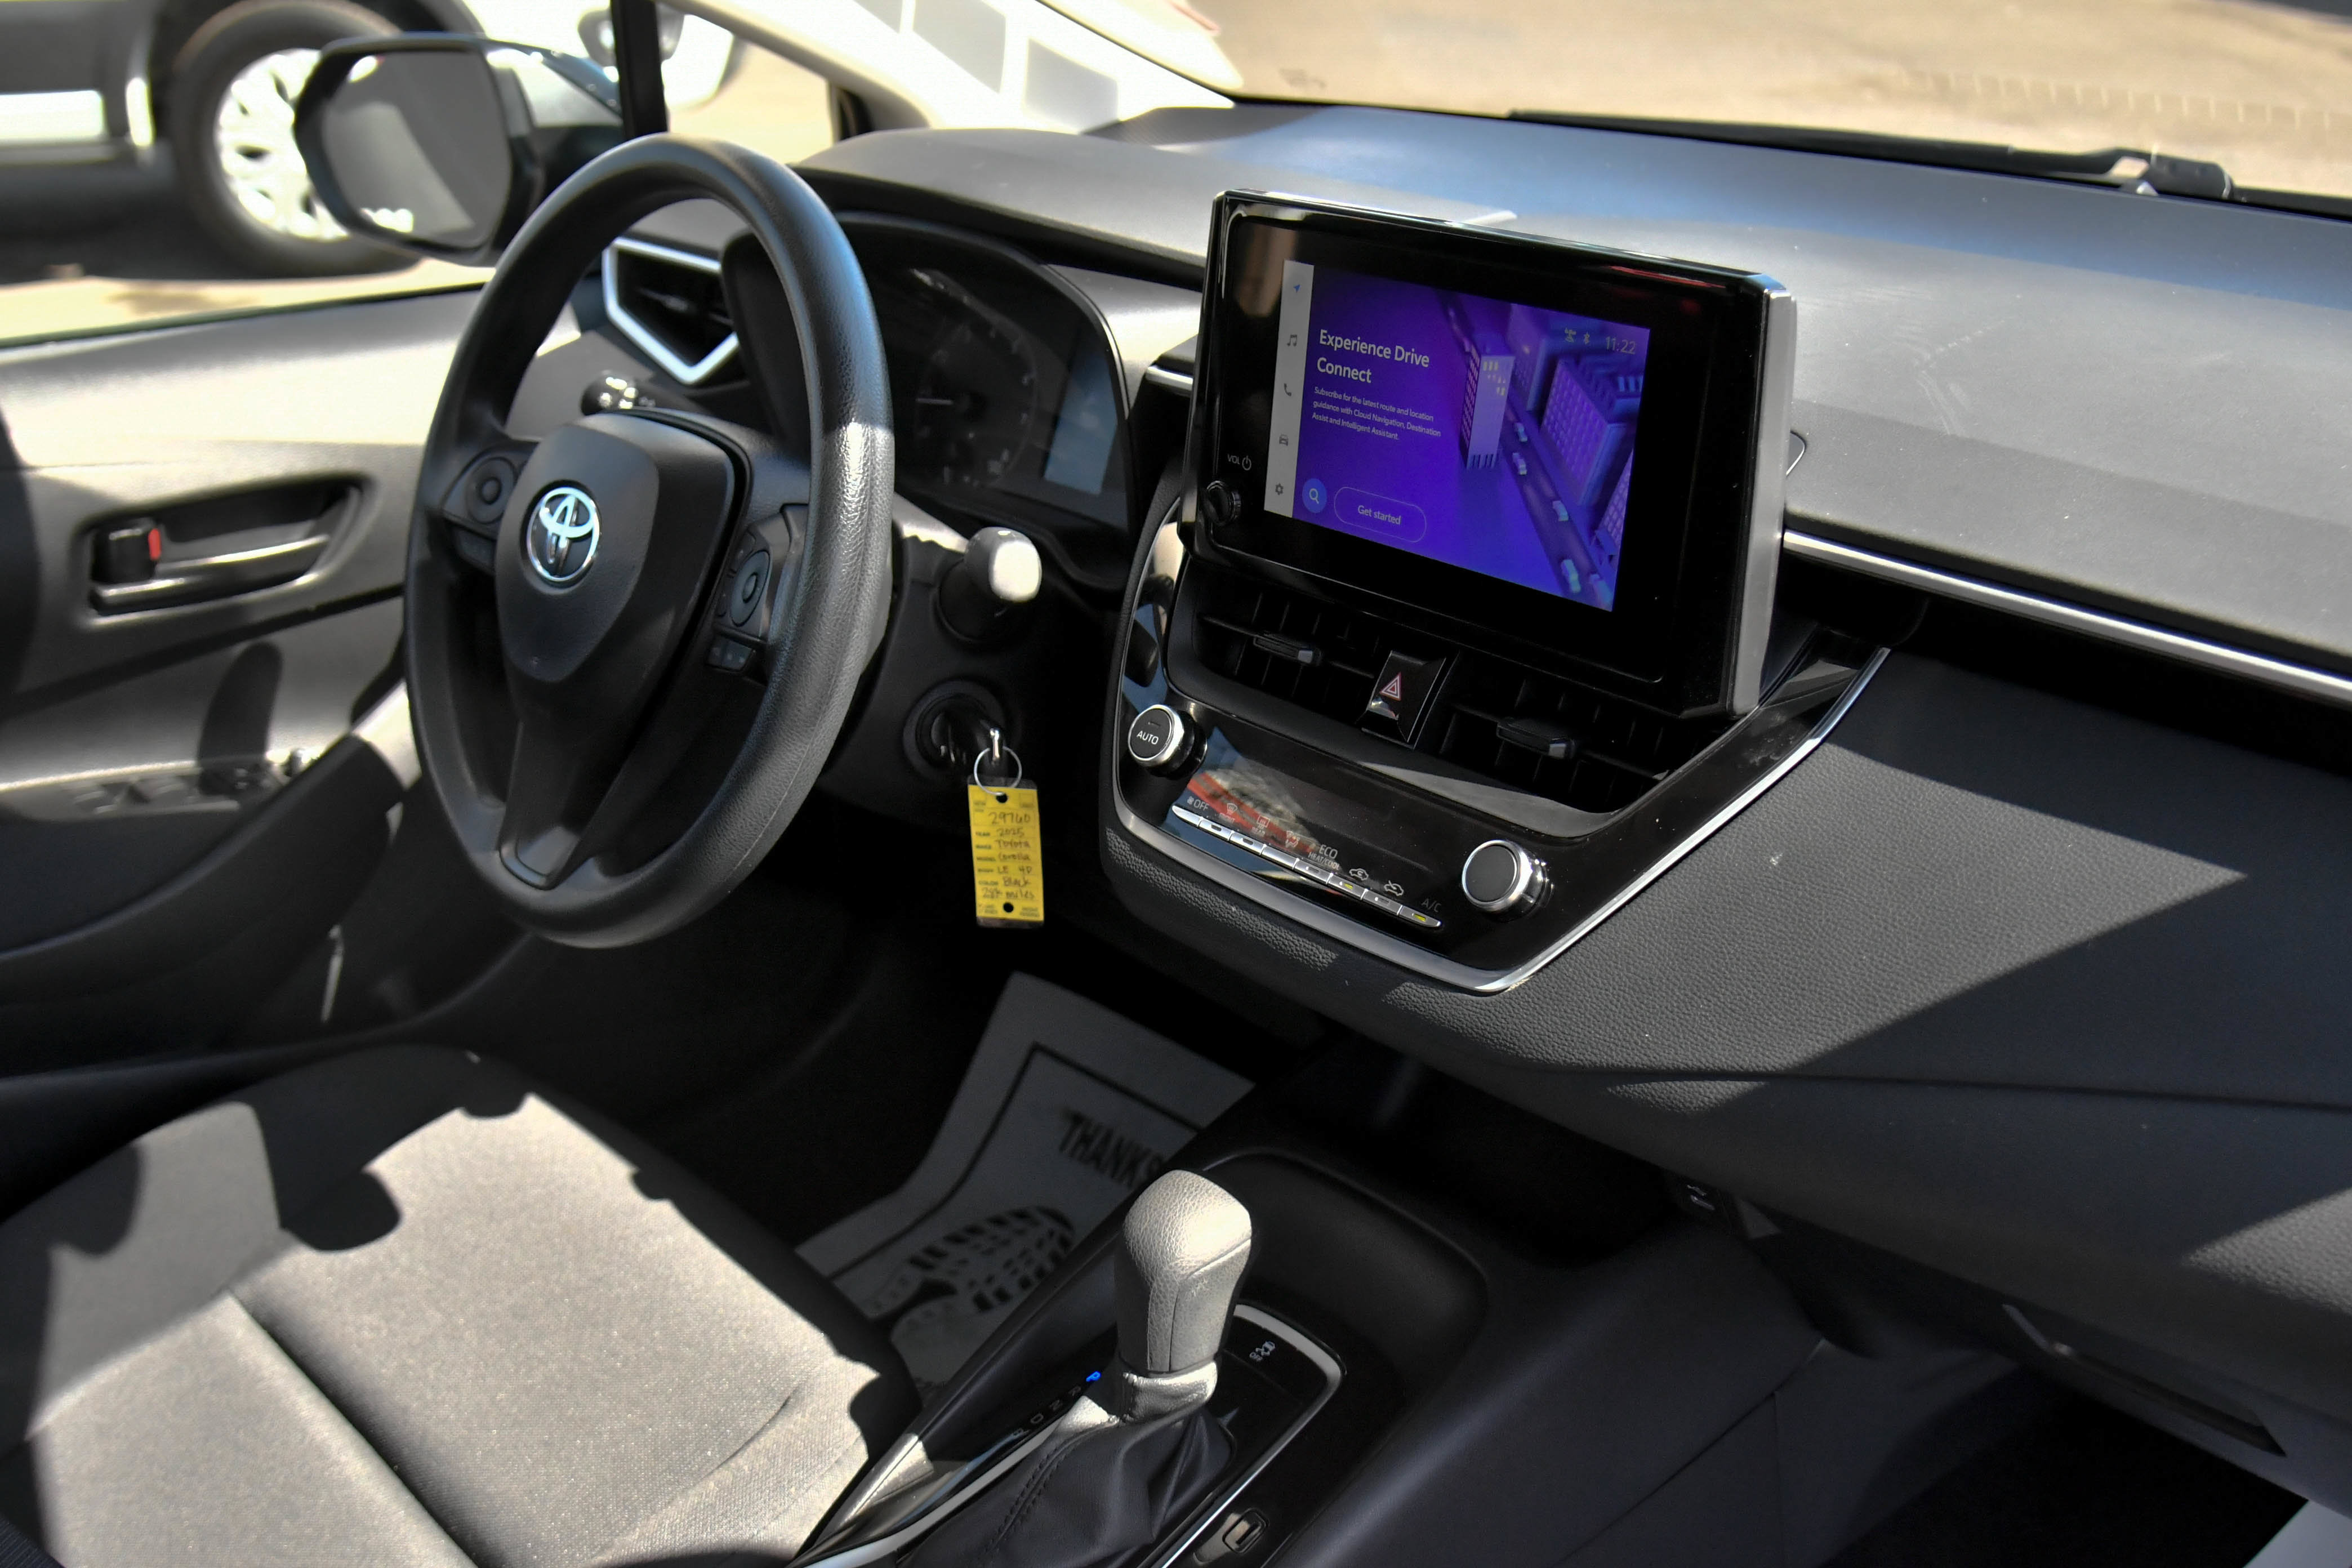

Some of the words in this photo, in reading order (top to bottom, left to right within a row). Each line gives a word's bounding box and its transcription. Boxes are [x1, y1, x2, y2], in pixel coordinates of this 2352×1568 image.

[1319, 329, 1392, 359] Experience
[1395, 345, 1429, 368] Drive
[1606, 336, 1636, 355] 11:22
[1317, 357, 1372, 384] Connect
[1314, 386, 1343, 400] Subscribe
[1343, 393, 1351, 402] for
[1352, 395, 1362, 404] the
[1362, 397, 1379, 409] latest
[1379, 404, 1396, 413] route
[1396, 407, 1409, 416] and
[1409, 408, 1434, 422] location
[1312, 412, 1329, 423] Assist
[1329, 417, 1341, 426] and
[1341, 418, 1371, 433] Intelligent
[1371, 427, 1400, 440] Assistant.
[1313, 400, 1340, 412] guidance
[1340, 406, 1353, 415] with
[1353, 408, 1371, 420] Cloud
[1372, 414, 1406, 429] Navigation,
[1406, 422, 1441, 437] Destination
[1227, 453, 1241, 465] VOL
[1357, 505, 1373, 518] Get
[1373, 510, 1402, 525] started
[1136, 730, 1159, 745] AUTO
[1193, 799, 1209, 812] OFF
[988, 811, 1031, 825] 29760
[1318, 844, 1338, 859] ECO
[1307, 851, 1340, 871] HEAT/COOL
[1421, 898, 1442, 913] A/C
[1085, 1370, 1102, 1382] P
[1030, 1413, 1044, 1424] D
